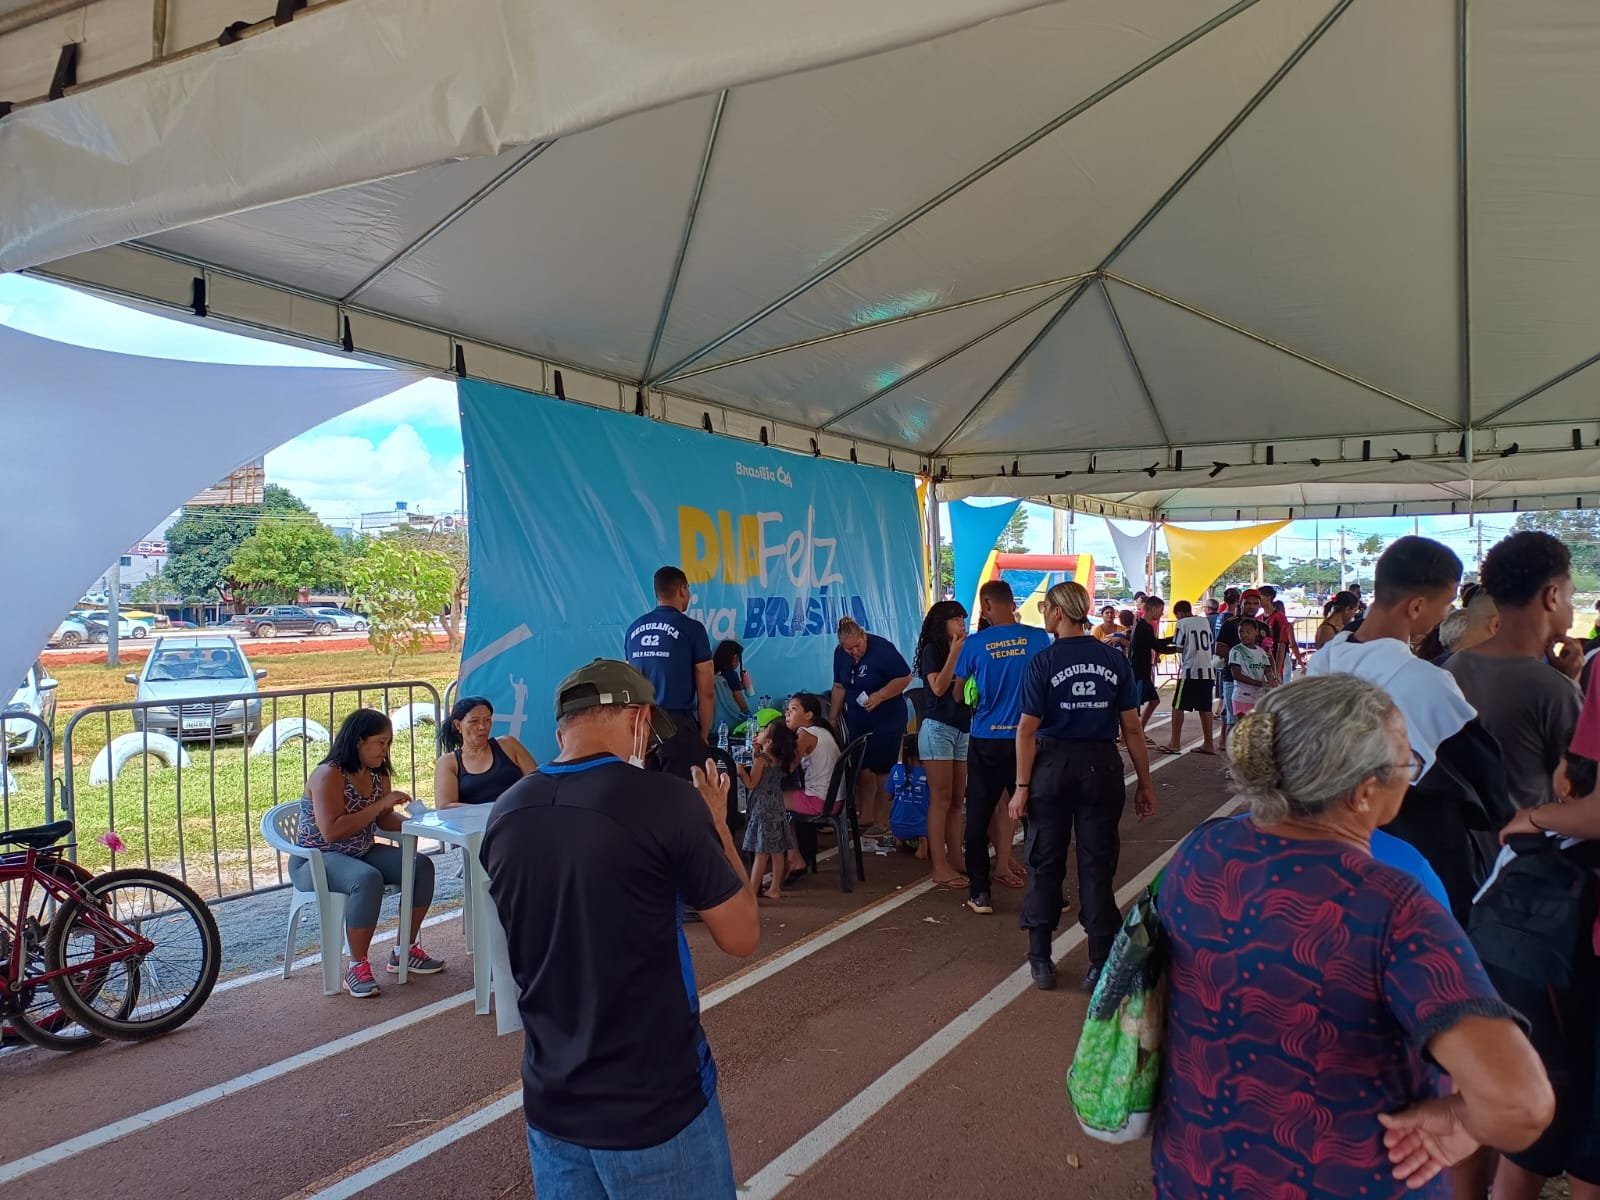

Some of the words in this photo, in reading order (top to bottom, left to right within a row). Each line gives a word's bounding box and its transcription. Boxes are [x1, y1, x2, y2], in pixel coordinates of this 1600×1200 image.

[736, 461, 775, 481] Brasília
[678, 505, 759, 585] DIA
[689, 594, 737, 641] iva
[630, 622, 680, 640] SEGURANÇA
[640, 634, 660, 647] G2
[1191, 630, 1209, 651] 10
[986, 637, 1027, 651] COMISSÃO
[991, 648, 1026, 660] TÉCNICA
[1050, 663, 1119, 688] SEGURANÇA
[1071, 680, 1097, 696] G2
